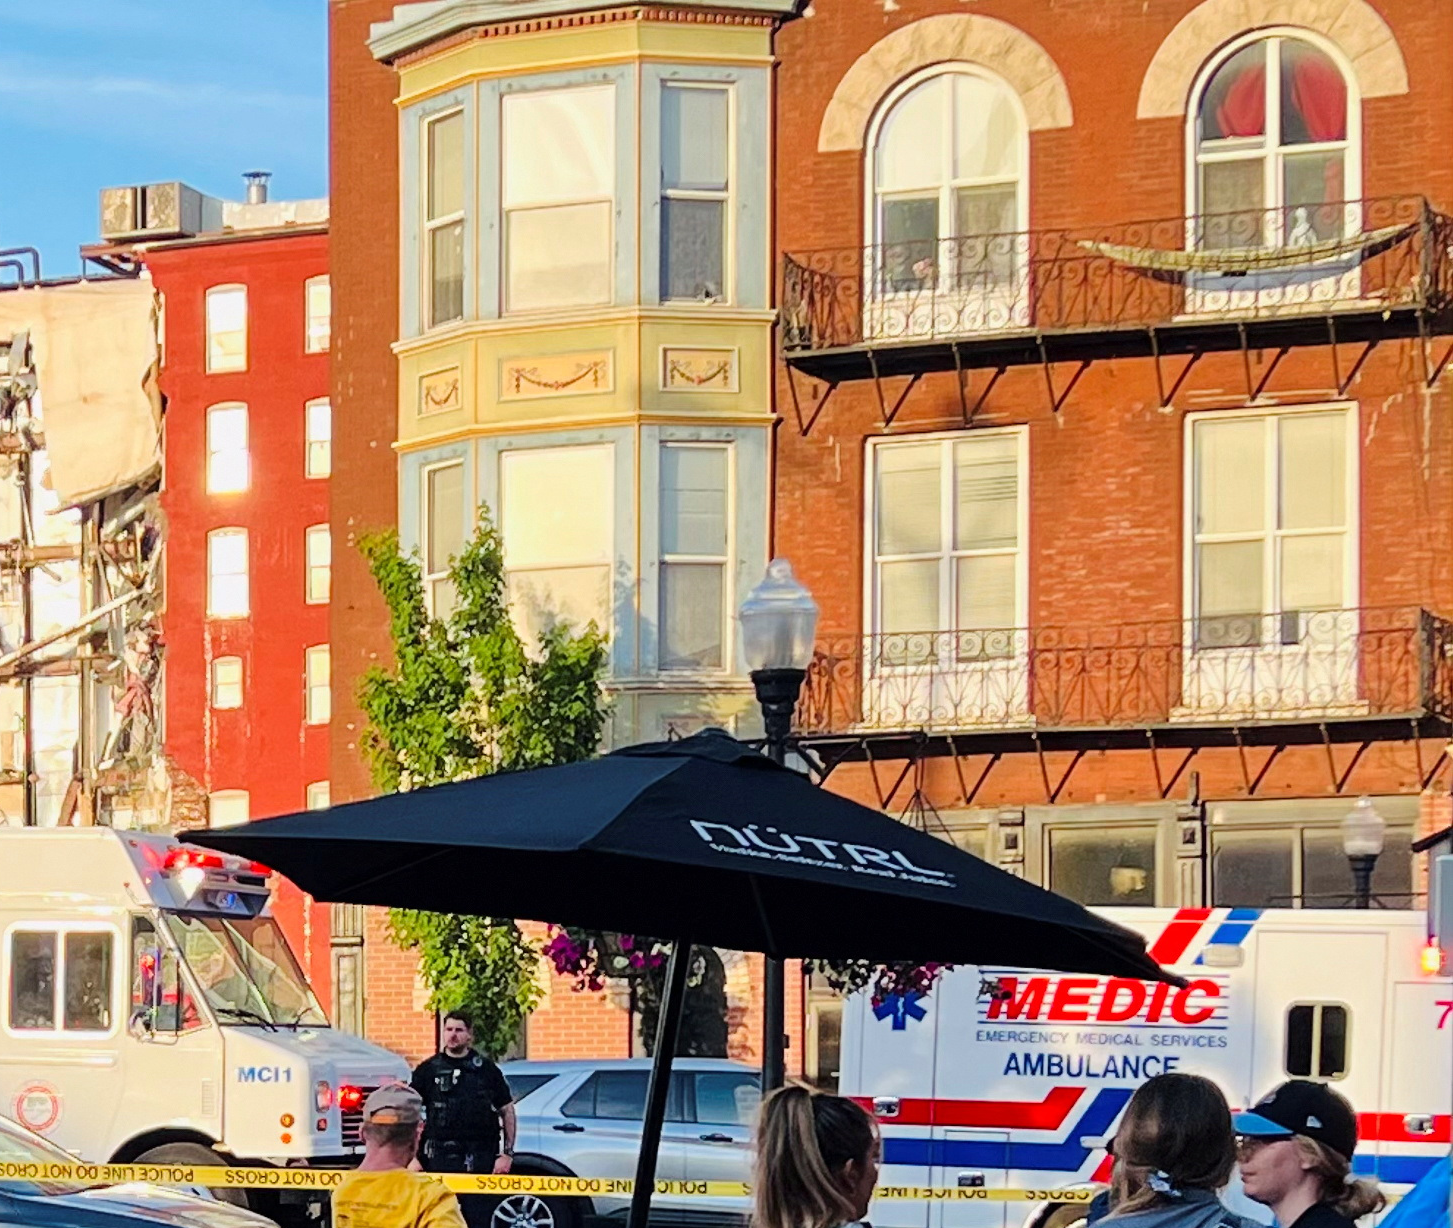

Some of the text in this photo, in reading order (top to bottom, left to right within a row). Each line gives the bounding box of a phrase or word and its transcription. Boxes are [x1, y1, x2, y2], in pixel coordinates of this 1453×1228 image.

[986, 976, 1221, 1024] MEDIC
[976, 1030, 1228, 1048] EMERGENCY MEDICAL SERVICES
[1003, 1052, 1180, 1079] AMBULANCE
[237, 1067, 292, 1083] MCI1
[42, 1163, 71, 1179] NOT
[76, 1164, 97, 1180] DO
[103, 1166, 135, 1181] LINE
[139, 1167, 194, 1183] POLICE
[225, 1169, 343, 1187] DO NOT CROSS
[475, 1175, 708, 1195] POLIC INE DO NOT CROSS
